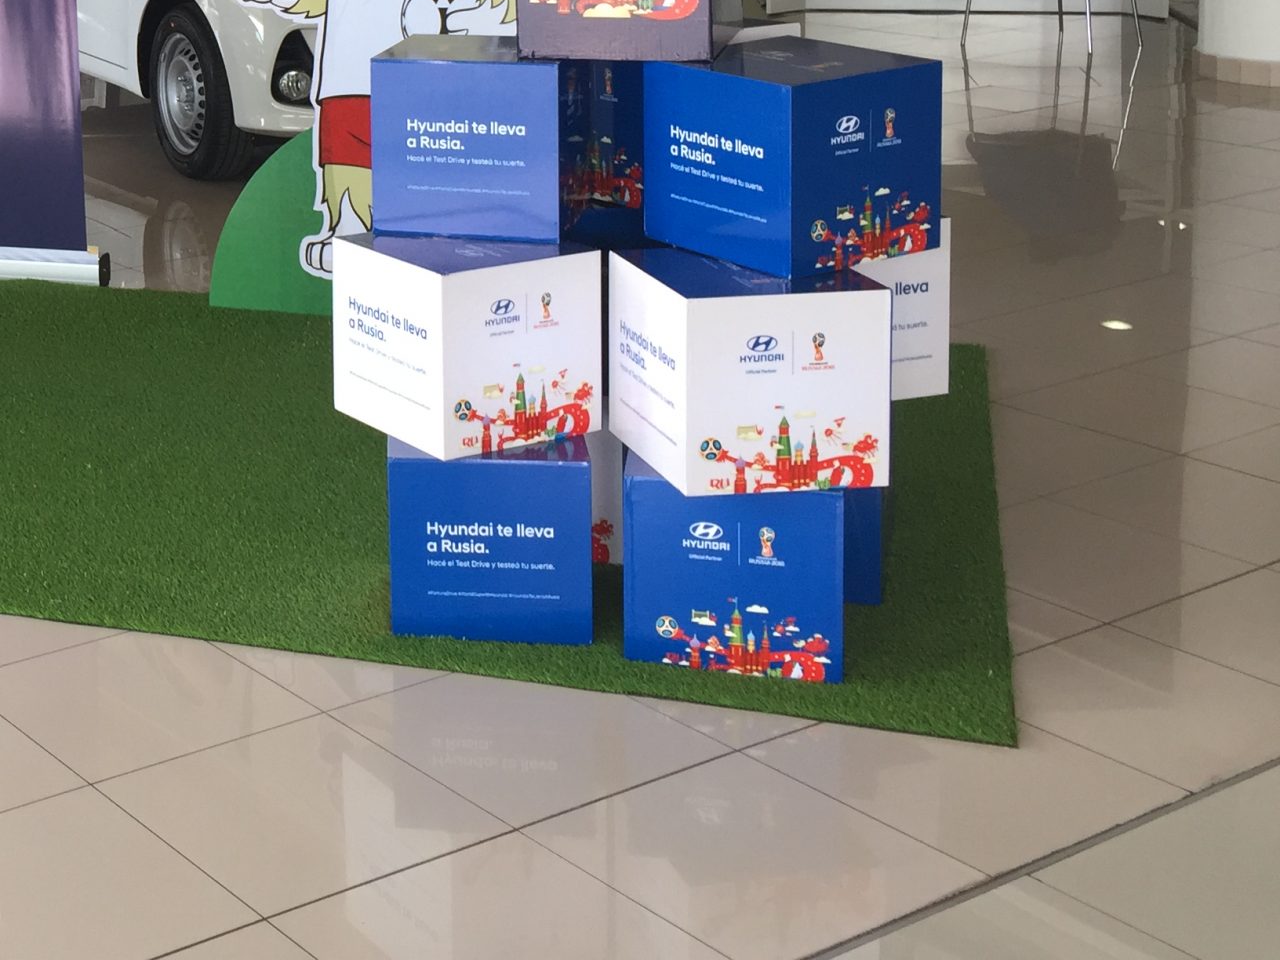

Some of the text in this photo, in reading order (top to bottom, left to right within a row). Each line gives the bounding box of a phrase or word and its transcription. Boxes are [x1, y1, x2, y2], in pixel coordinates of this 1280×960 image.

[406, 118, 526, 136] Hyundai te lleva
[406, 136, 465, 150] a Rusia.
[670, 124, 764, 159] Hyundai te lleva
[830, 132, 865, 146] HYUNDAI
[670, 144, 716, 166] a Rusia.
[895, 281, 929, 296] lleva
[349, 296, 427, 340] Hyundai te lleva
[485, 314, 521, 327] HYUNDAI
[349, 318, 387, 342] a Rusia.
[739, 353, 784, 364] HYUNDAI
[426, 521, 555, 539] Hyundai te lleva
[426, 539, 490, 554] a Rusia.
[682, 538, 730, 551] HYUNDAI
